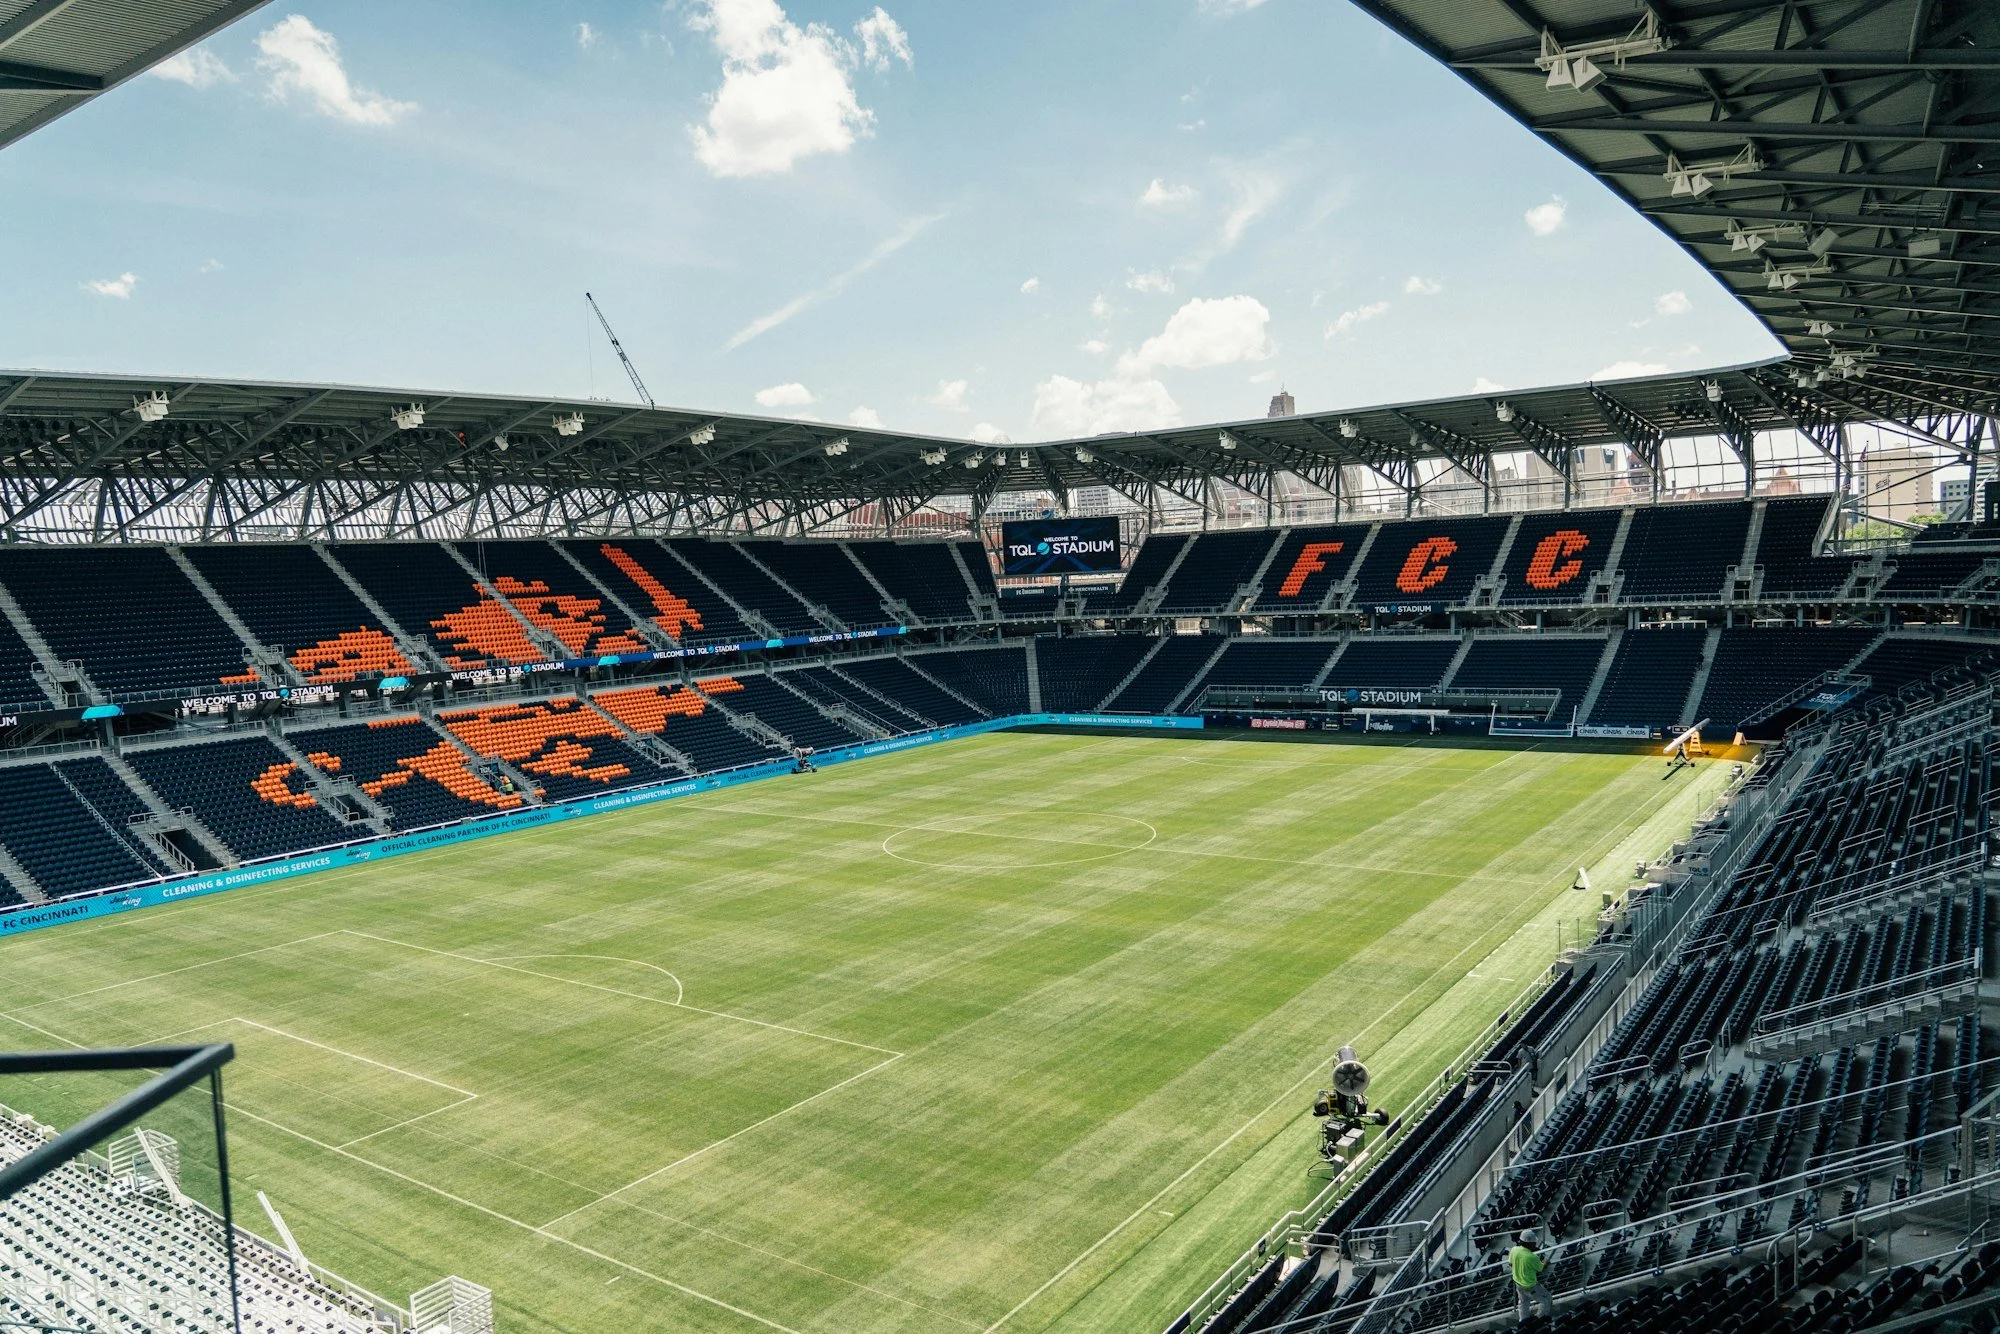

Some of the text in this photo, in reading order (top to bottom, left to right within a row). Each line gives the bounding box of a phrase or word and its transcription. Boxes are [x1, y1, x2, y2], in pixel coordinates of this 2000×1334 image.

[1009, 540, 1114, 557] TQL STADIUM
[1278, 530, 1590, 597] F C C
[808, 634, 833, 643] WELCOME
[857, 630, 878, 638] STADIUM
[652, 649, 684, 659] WELCOME
[697, 647, 709, 655] TQL
[715, 644, 739, 653] STADIUM
[451, 662, 564, 680] WELCOME TO TQL STADIUM
[181, 685, 334, 708] WELCOME TO TQL STADIUM
[1319, 690, 1421, 702] TQL STADIUM
[863, 744, 885, 754] CLEANING
[916, 735, 933, 744] SERVICES
[727, 763, 796, 782] OFFICIAL CLEANING PARTNE
[593, 797, 625, 810] CLEANING
[631, 787, 671, 802] DISINFECTING
[671, 783, 697, 794] SERVICES
[381, 812, 551, 853] OFFICIAL CLEANING PARTNER OF FC CINCINNATI
[162, 857, 331, 898] CLEANING & DISINFECTING SERVICES
[3, 905, 89, 929] FC CINCINNATI
